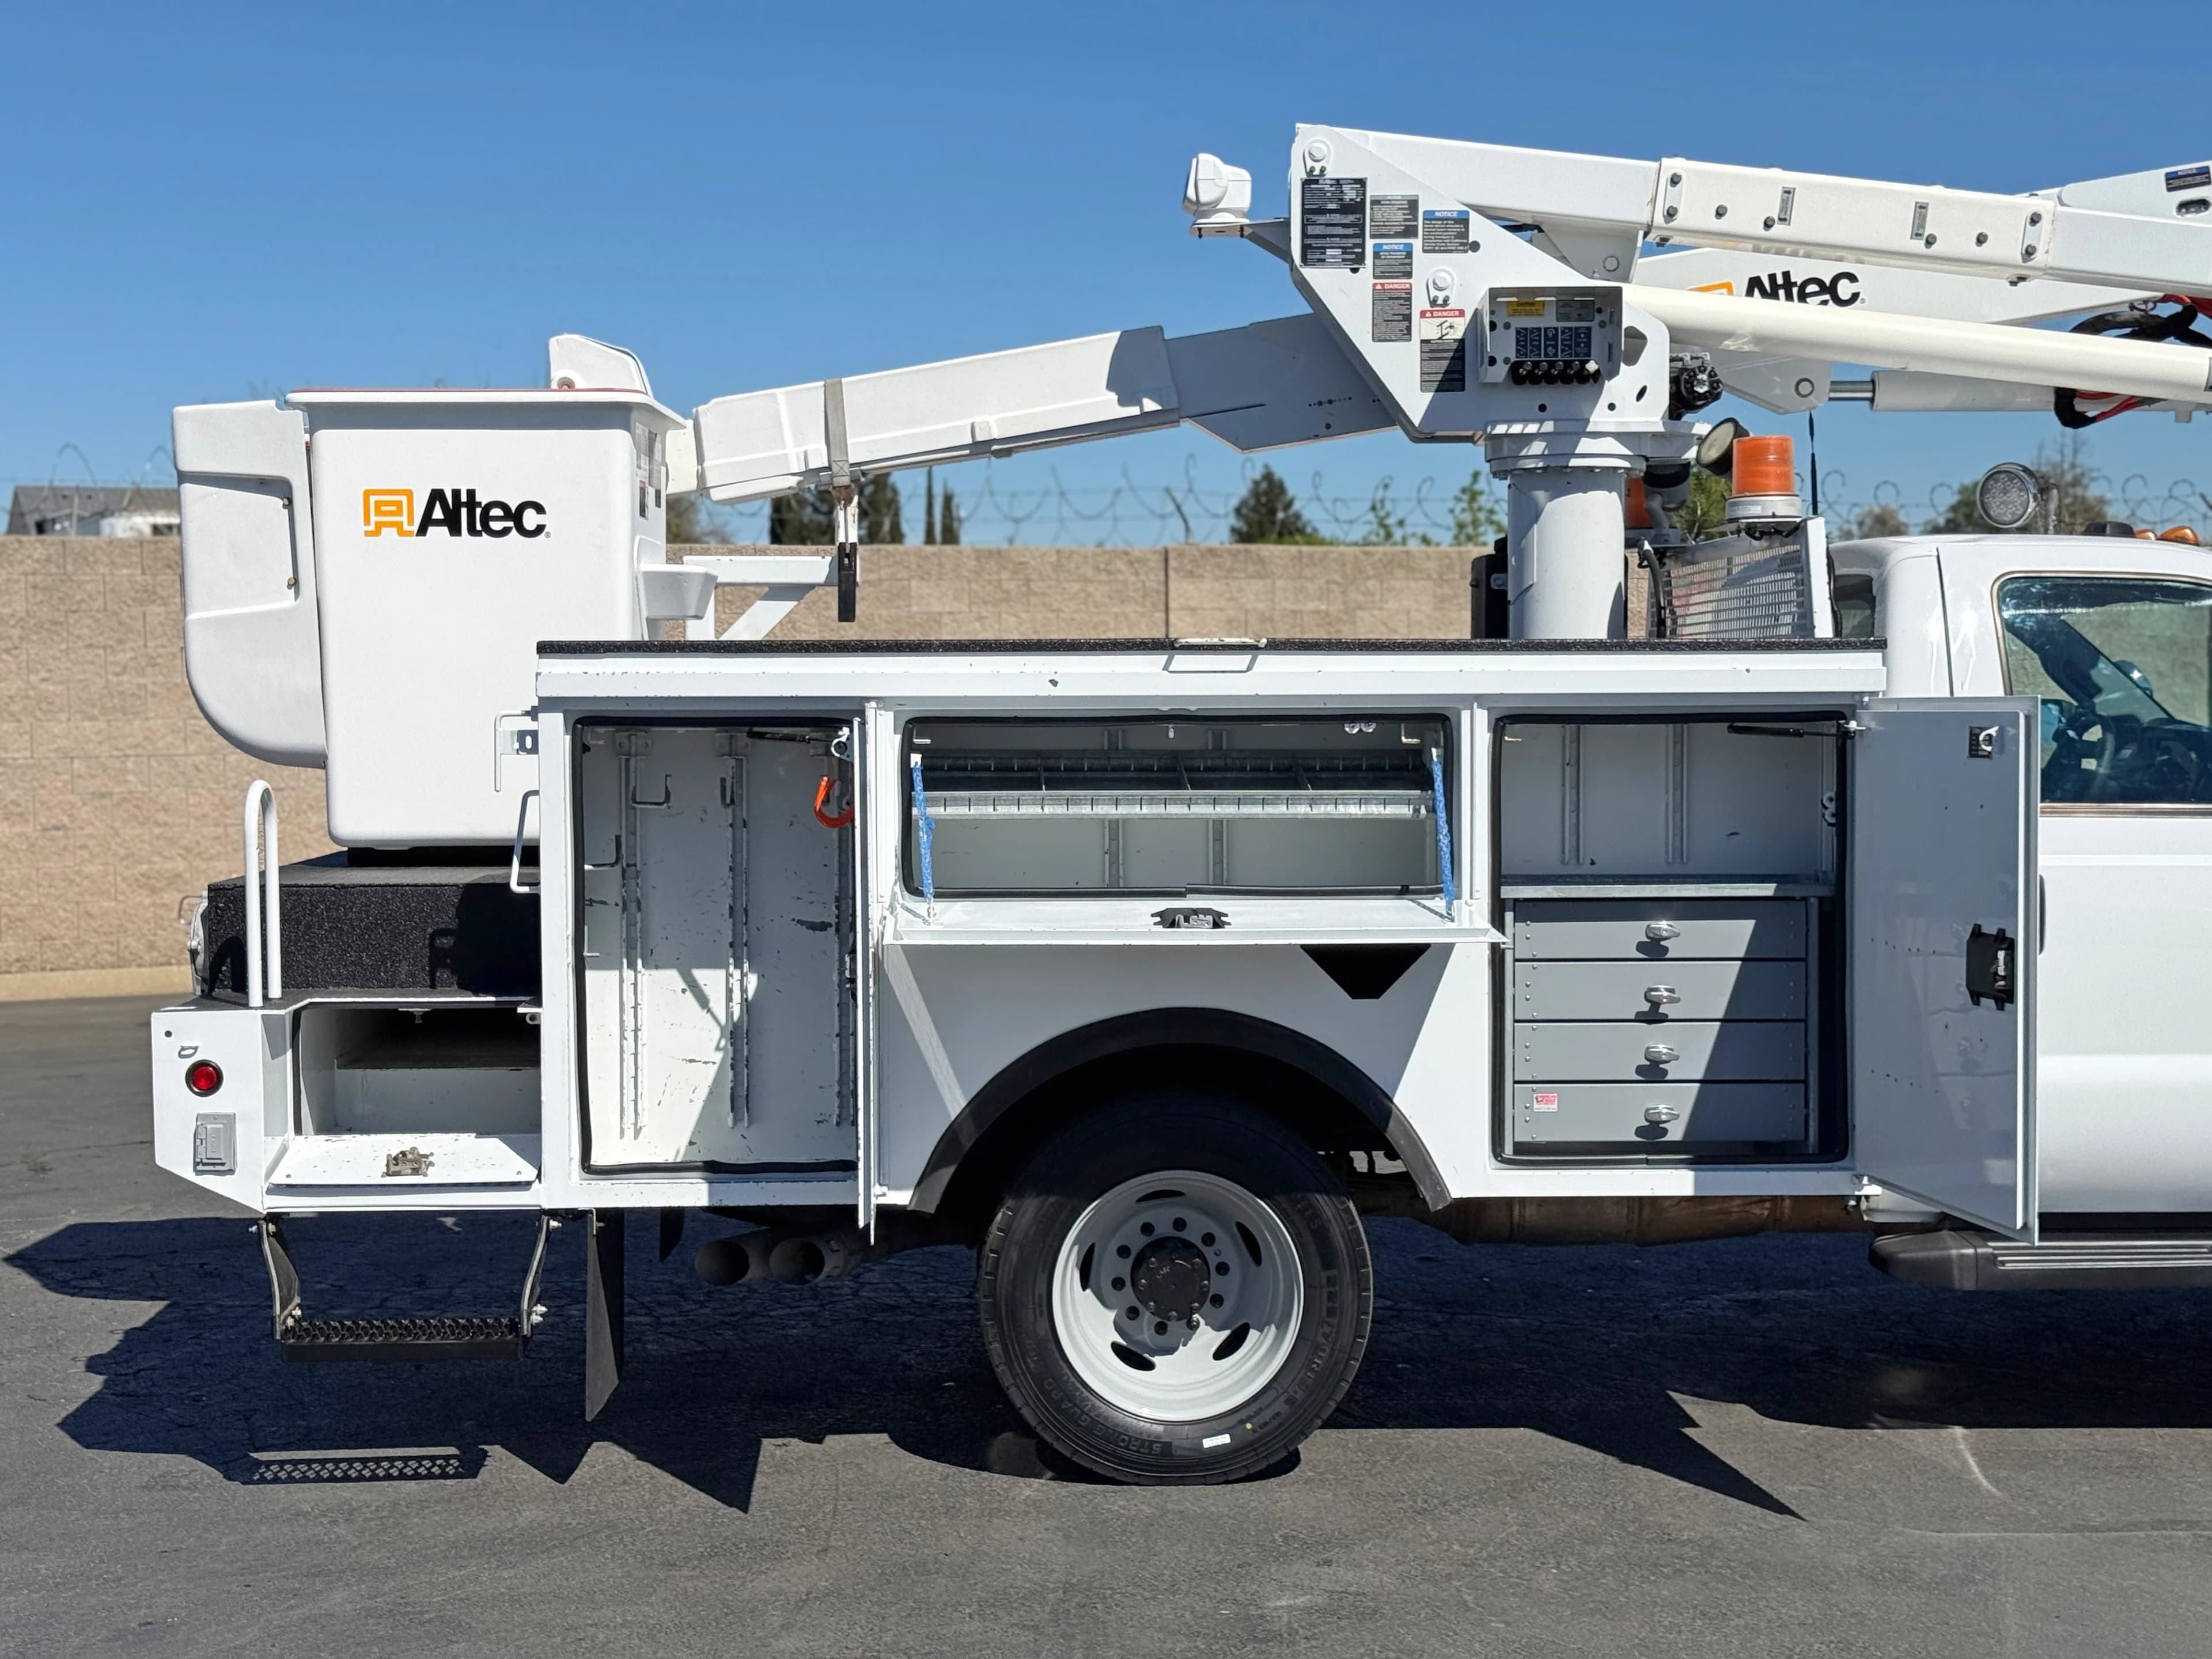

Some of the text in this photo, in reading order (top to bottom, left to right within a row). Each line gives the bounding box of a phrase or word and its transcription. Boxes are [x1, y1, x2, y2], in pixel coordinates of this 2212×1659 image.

[1745, 270, 1861, 307] Altec
[415, 488, 547, 538] Altec
[1094, 1425, 1162, 1455] STRONG
